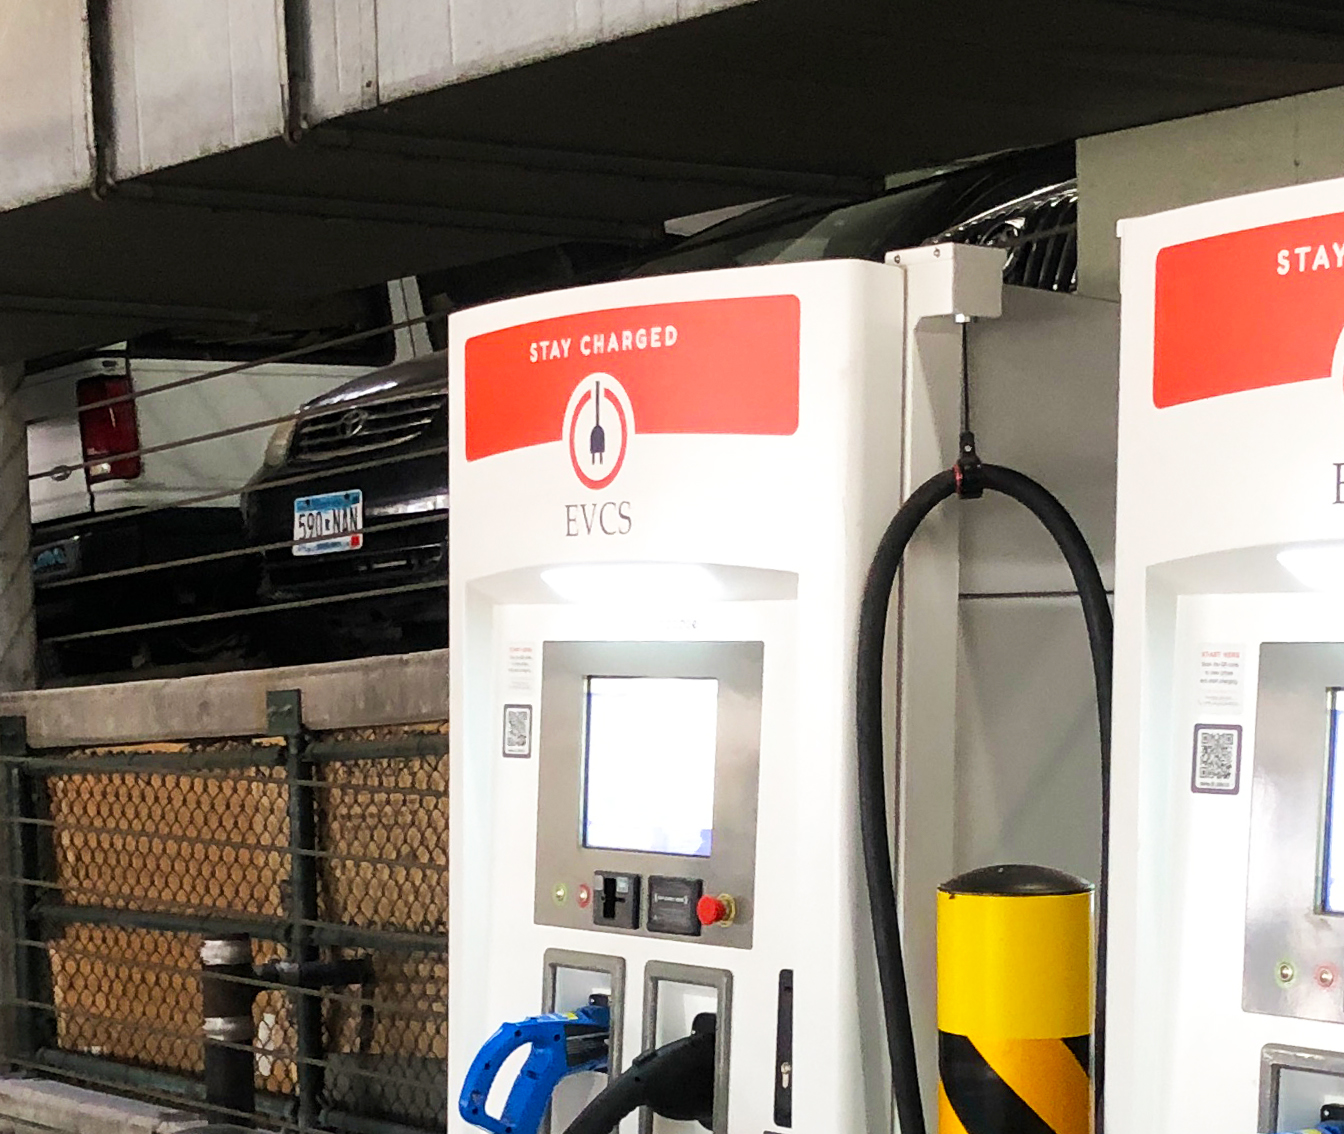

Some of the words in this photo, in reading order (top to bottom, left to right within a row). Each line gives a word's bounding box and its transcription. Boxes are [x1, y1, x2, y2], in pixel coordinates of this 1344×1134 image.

[529, 338, 571, 363] STAY
[580, 325, 678, 356] CHARGED
[564, 501, 633, 537] EVCS
